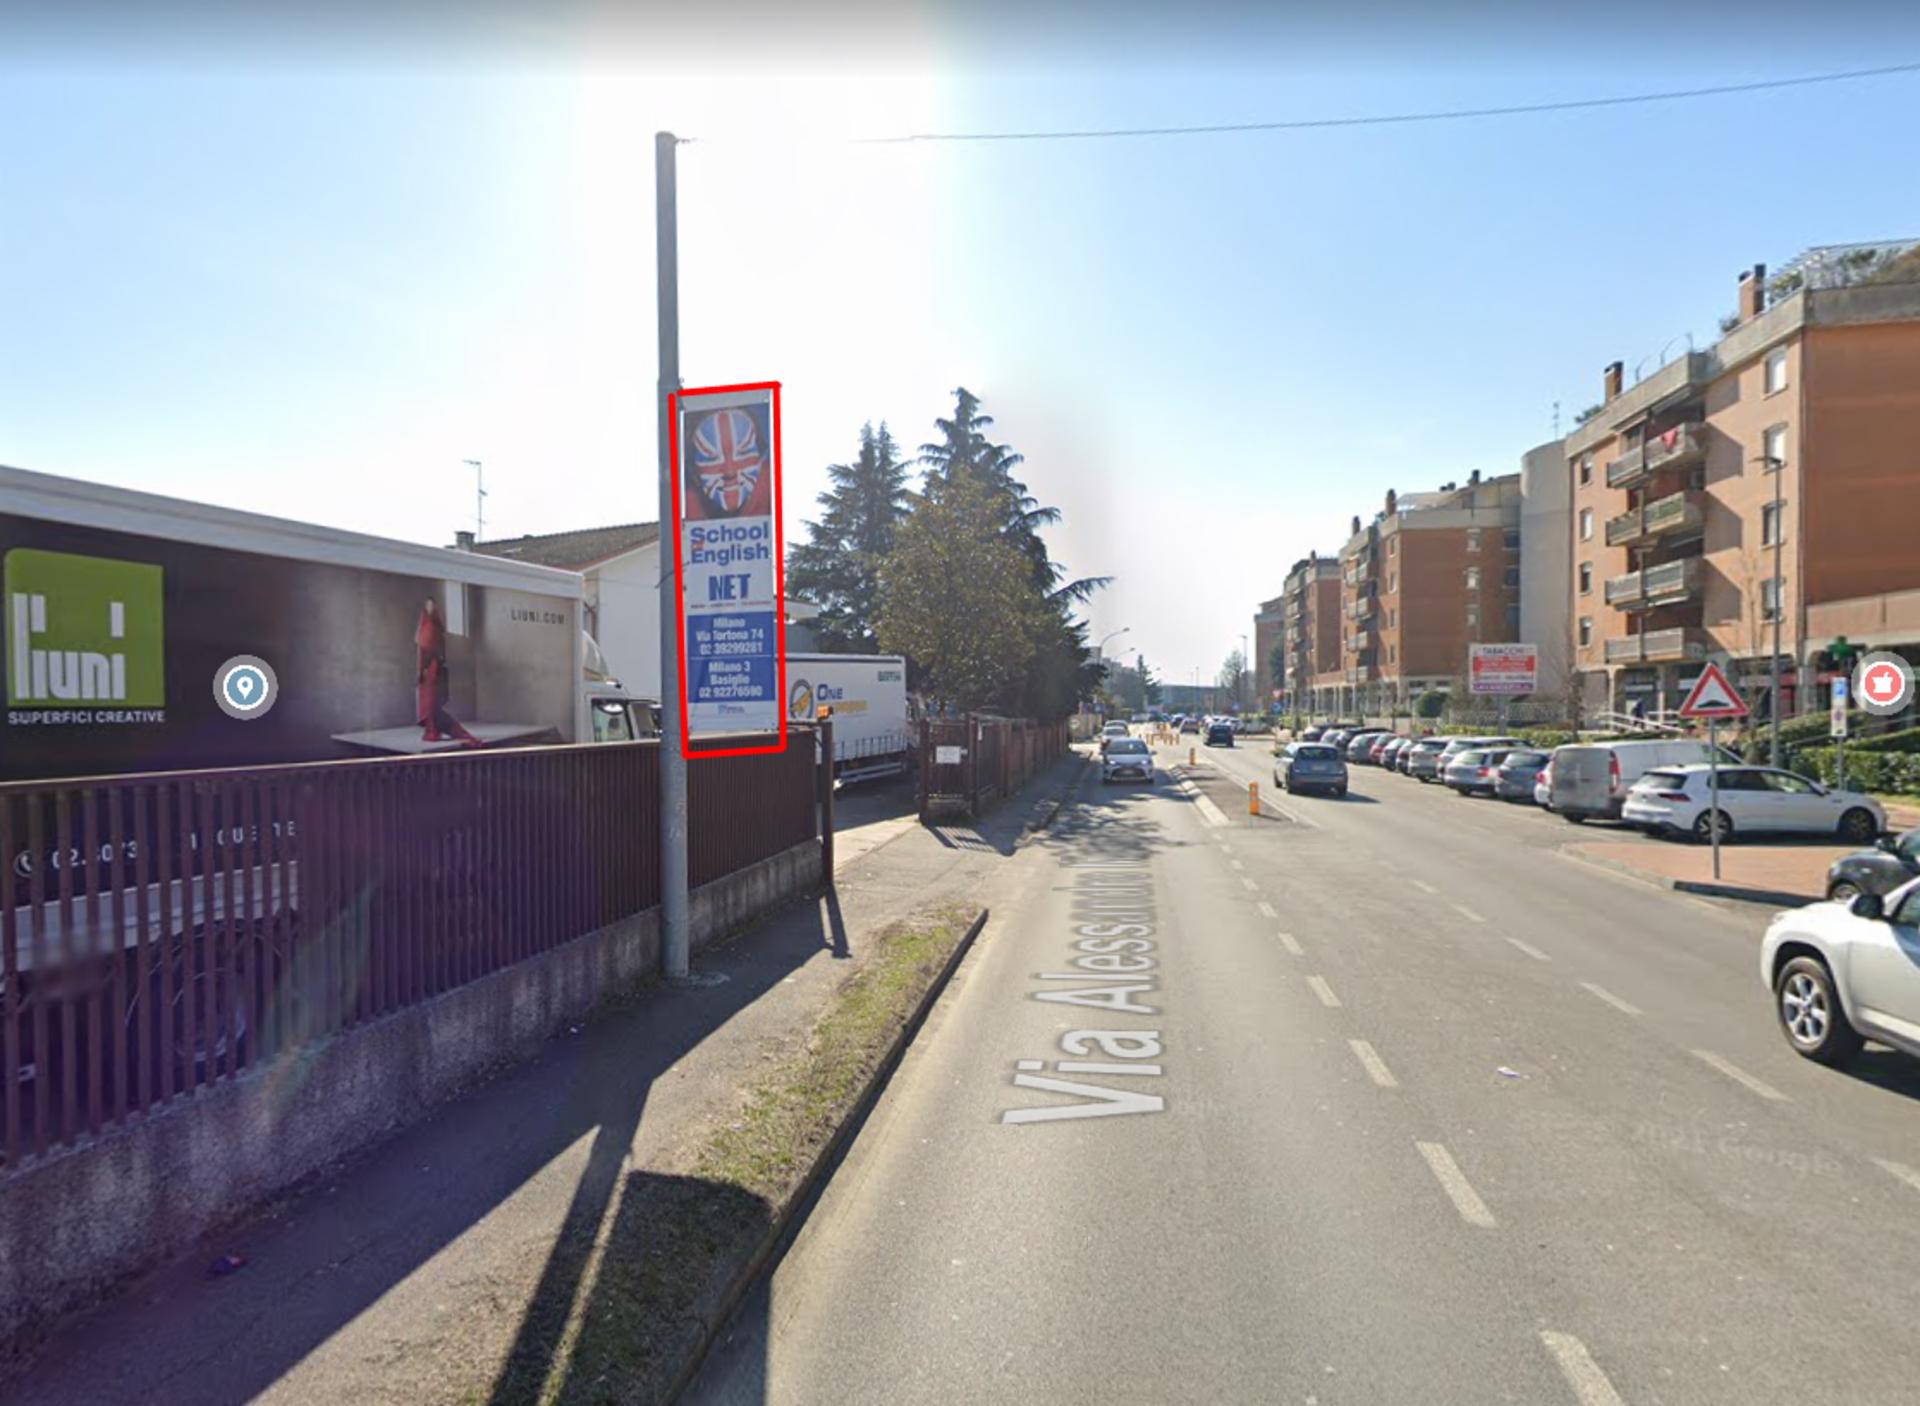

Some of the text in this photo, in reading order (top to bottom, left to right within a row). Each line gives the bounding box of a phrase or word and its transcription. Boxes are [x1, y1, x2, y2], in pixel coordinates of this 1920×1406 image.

[691, 521, 769, 543] School
[691, 543, 769, 566] English
[708, 573, 751, 601] NET
[713, 617, 746, 628] Milano
[696, 628, 764, 641] Via Tortona 74
[708, 660, 751, 673] Milano 3
[8, 710, 165, 725] SUPERFICI CREATIVE
